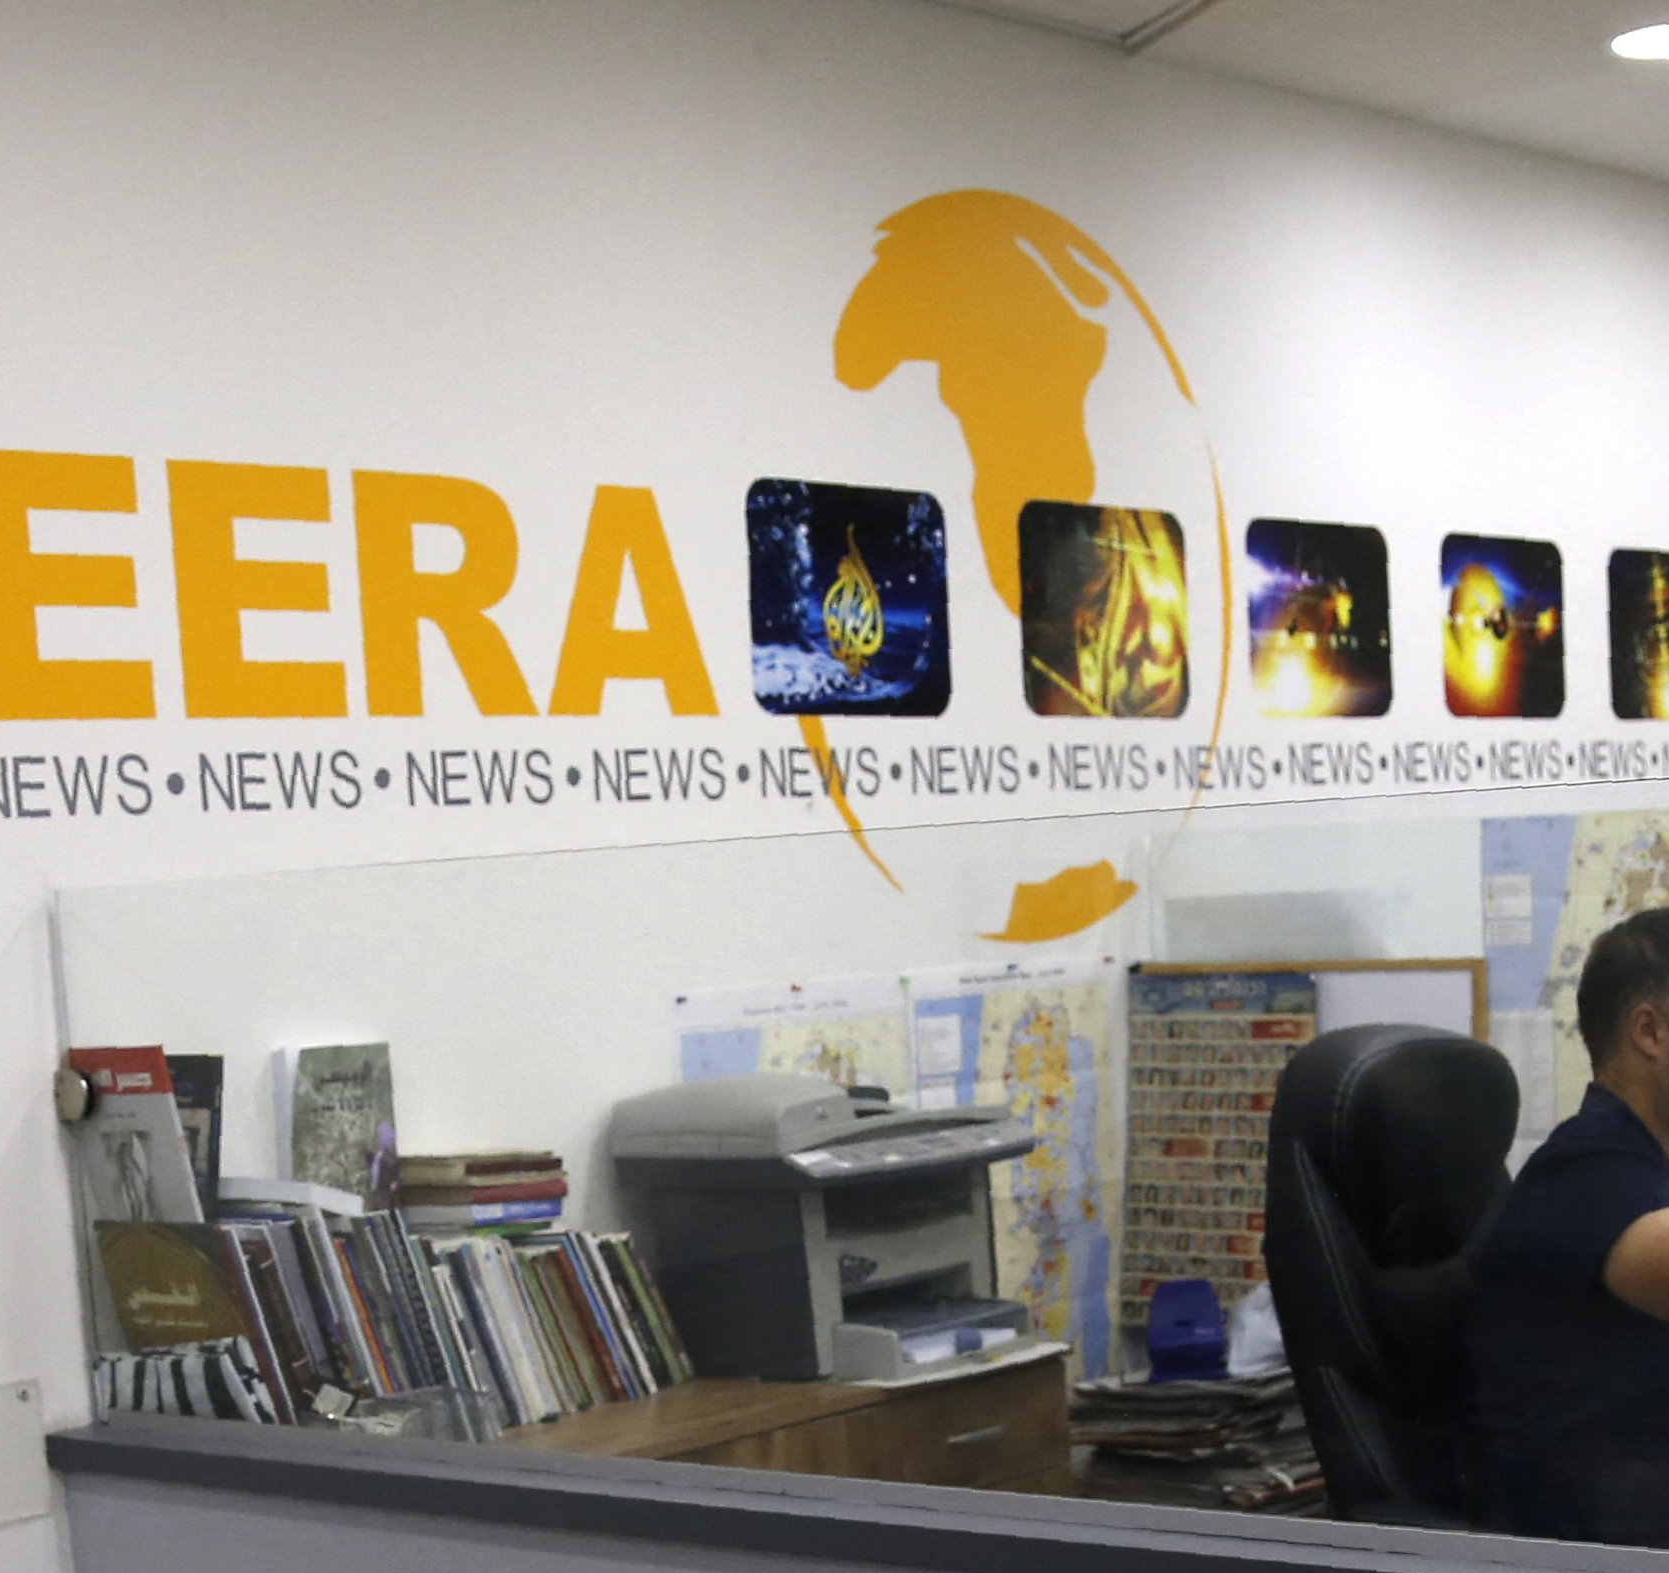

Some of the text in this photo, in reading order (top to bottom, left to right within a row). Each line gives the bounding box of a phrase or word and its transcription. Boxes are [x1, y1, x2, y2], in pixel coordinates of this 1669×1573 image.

[198, 749, 362, 812] NEWS
[406, 748, 555, 807] NEWS
[592, 746, 727, 802] NEWS
[758, 745, 880, 800] NEWS
[910, 745, 1020, 795] NEWS
[1048, 744, 1148, 791] NEWS
[1173, 736, 1266, 793] NEWS
[1288, 742, 1374, 786] NEWS
[1393, 741, 1471, 783] NEWS
[1488, 737, 1564, 782] NEWS
[1577, 737, 1648, 782] NEWS
